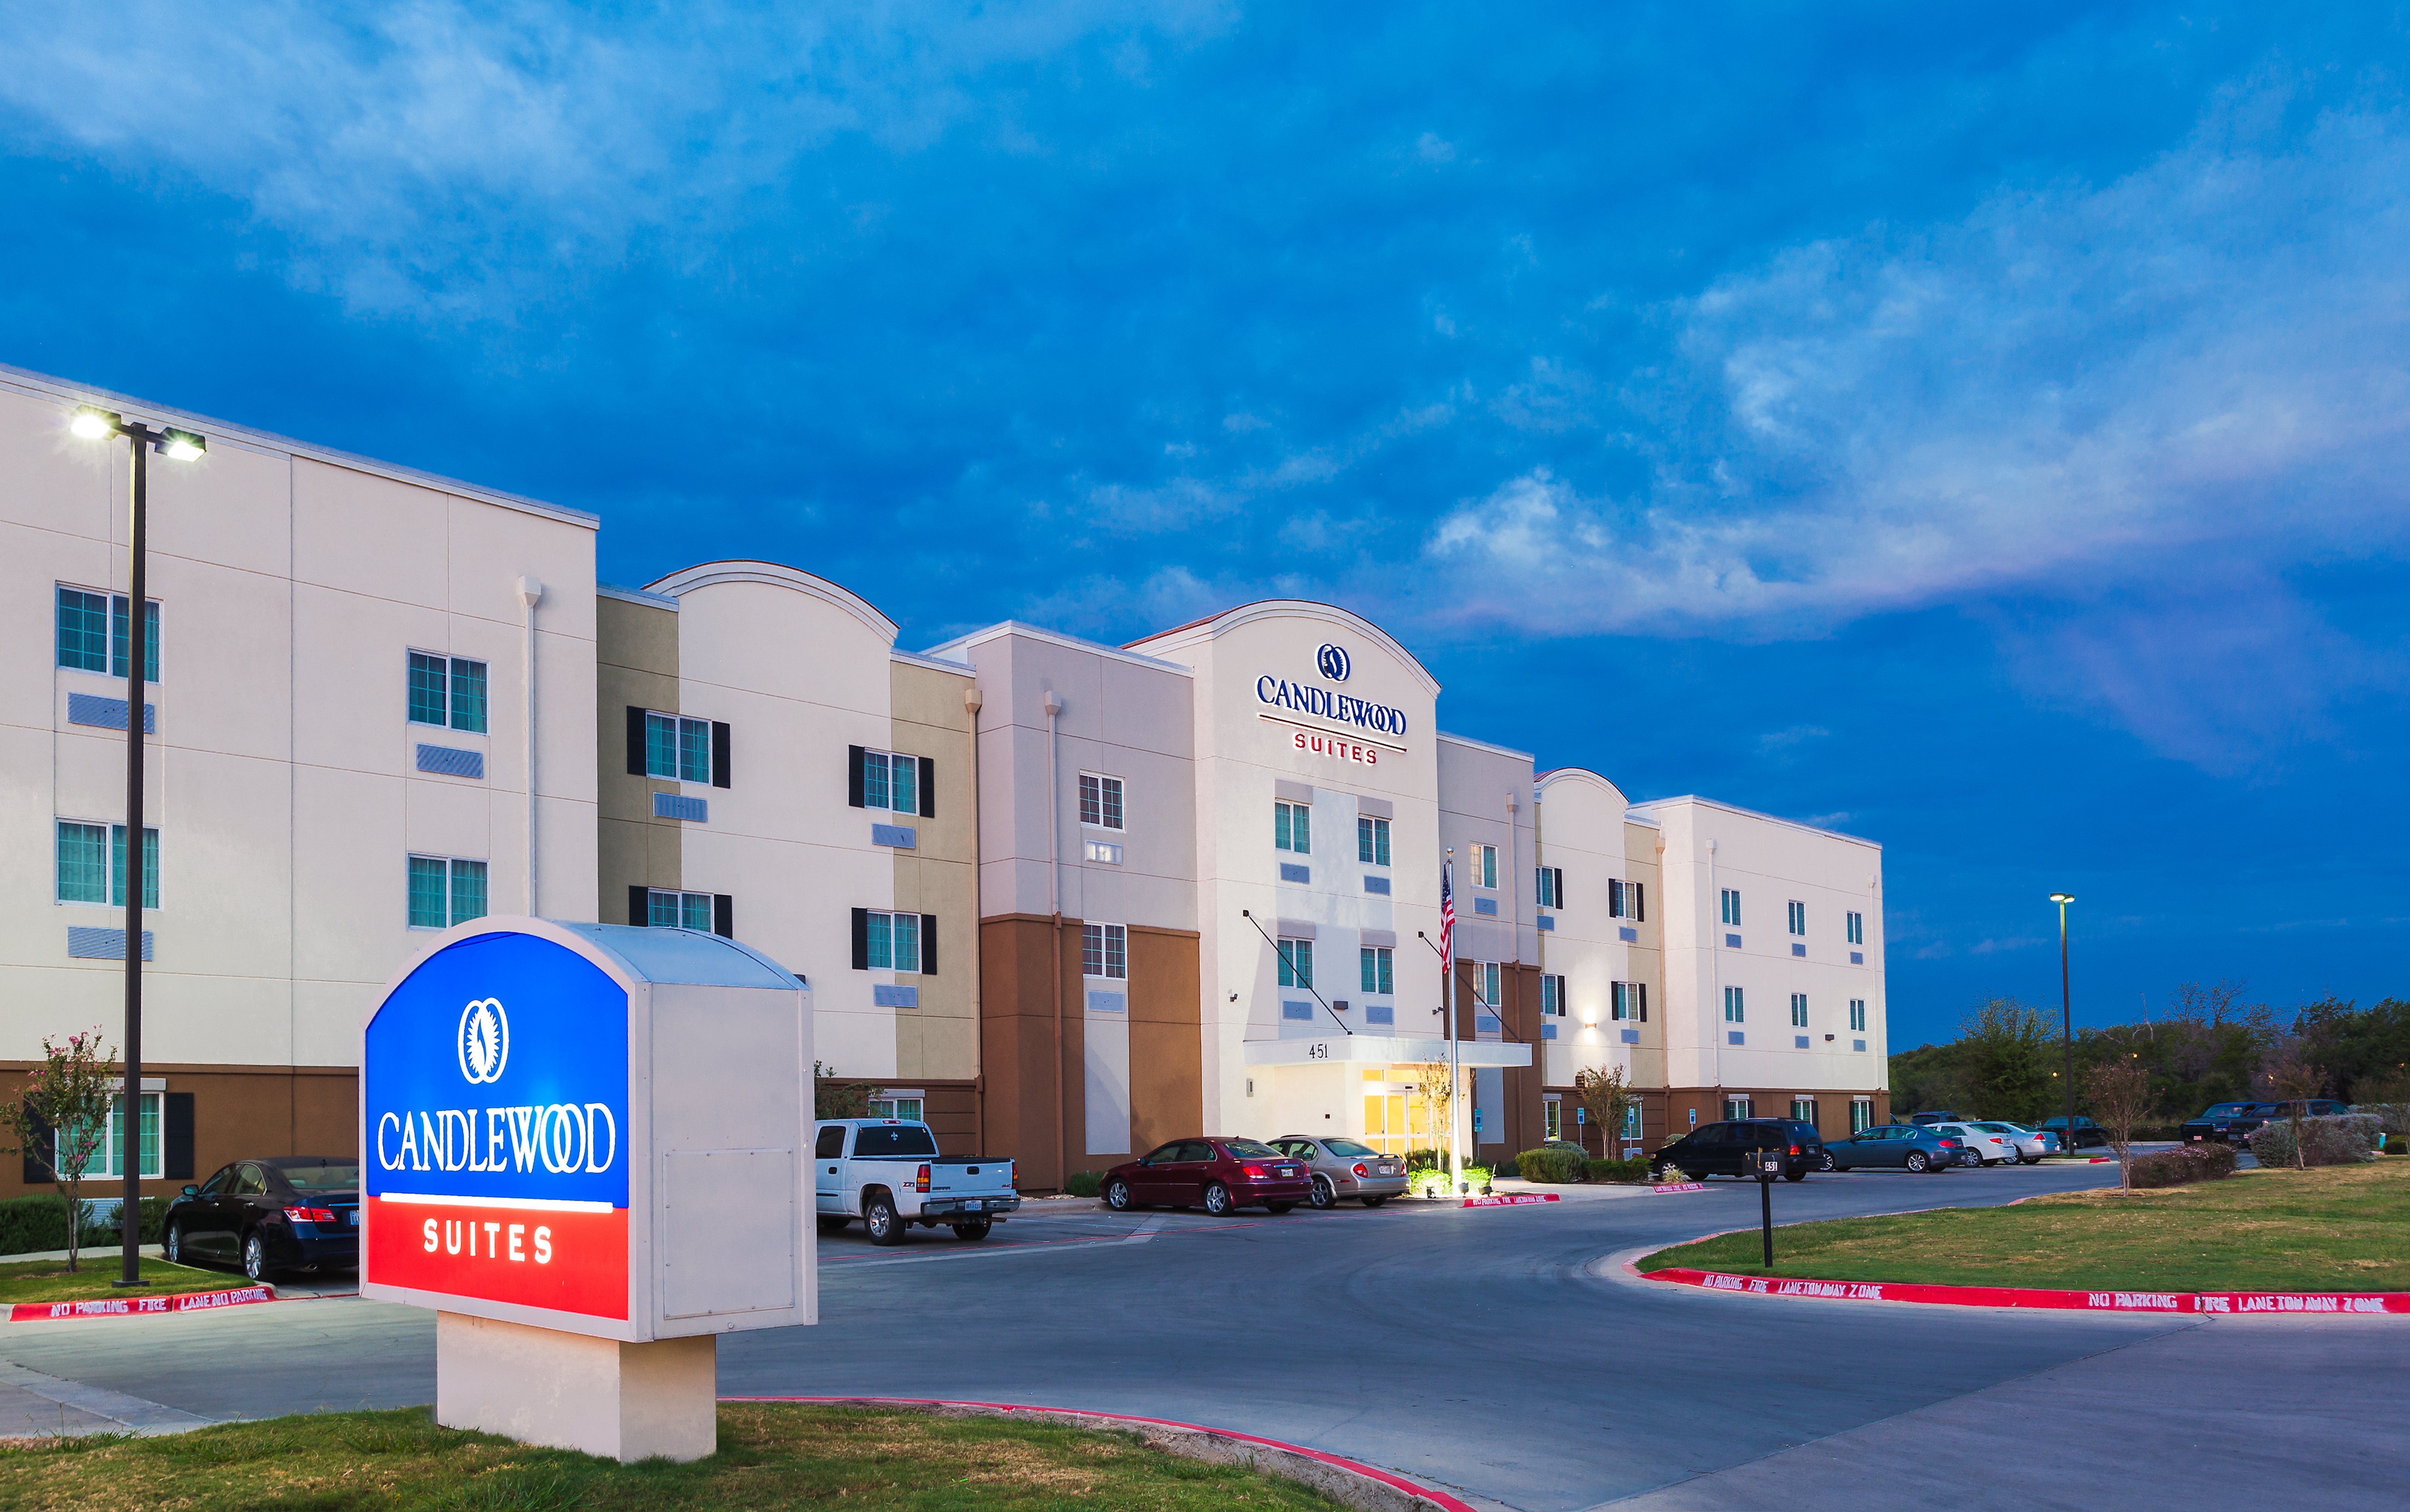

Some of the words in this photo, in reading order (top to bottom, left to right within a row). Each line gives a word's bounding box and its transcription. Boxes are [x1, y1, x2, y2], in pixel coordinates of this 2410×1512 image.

[1256, 675, 1407, 736] CANDLEWOOD
[1294, 733, 1377, 765] SUITES
[1309, 1044, 1328, 1059] 451
[378, 1102, 616, 1174] CANDLEWOOD
[1766, 1162, 1777, 1171] 451
[423, 1218, 552, 1264] SUITES
[50, 1303, 70, 1317] NO
[75, 1300, 128, 1315] PARKING
[138, 1298, 166, 1311] FIRE
[180, 1294, 210, 1311] LANE
[211, 1292, 229, 1307] NO
[230, 1287, 267, 1304] PARKING
[1703, 1274, 1714, 1287] NO
[1714, 1275, 1743, 1290] PARKING
[1749, 1279, 1769, 1293] FIRE
[1778, 1281, 1803, 1295] LANE
[1848, 1284, 1883, 1300] ZONE
[2089, 1293, 2110, 1307] NO
[2115, 1293, 2177, 1308] PARKING
[2194, 1297, 2230, 1312] FIRE
[2238, 1296, 2276, 1311] LANE
[2343, 1297, 2388, 1313] ZONE
